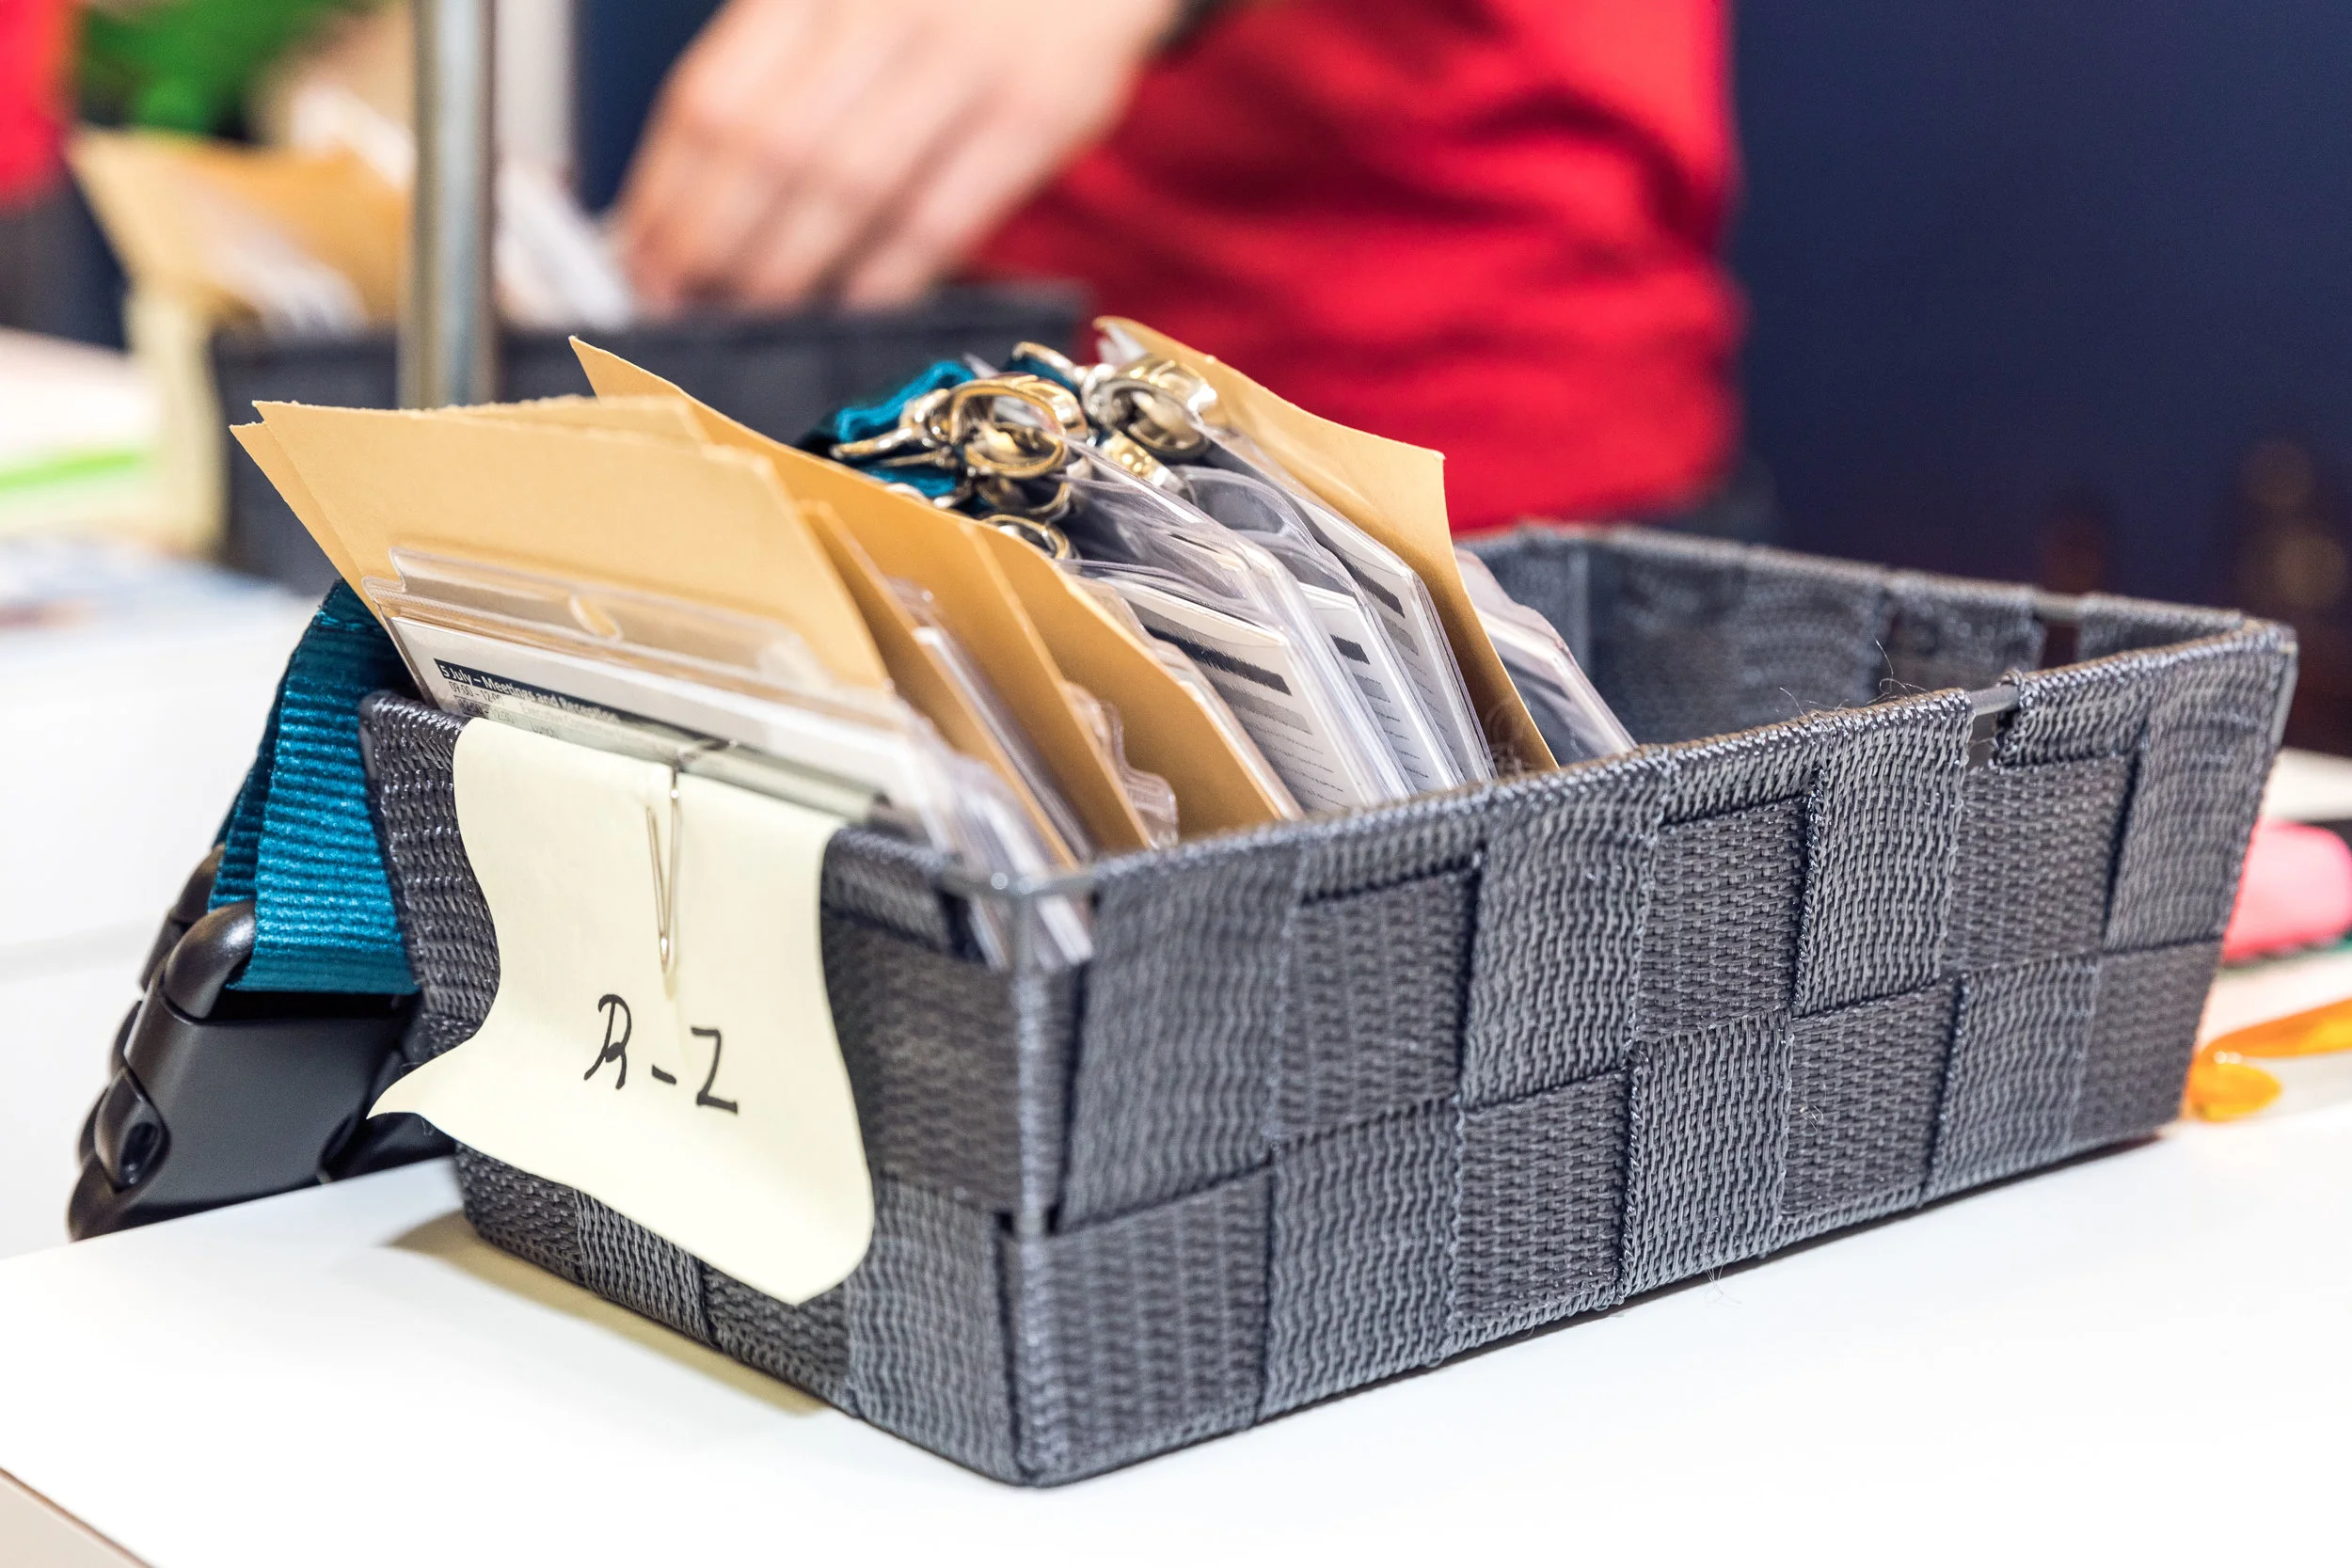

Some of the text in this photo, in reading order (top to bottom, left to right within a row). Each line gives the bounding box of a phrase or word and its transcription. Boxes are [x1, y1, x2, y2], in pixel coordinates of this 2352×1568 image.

[439, 664, 451, 678] 5
[450, 667, 473, 687] July
[481, 675, 536, 702] Meetings
[535, 692, 560, 709] and
